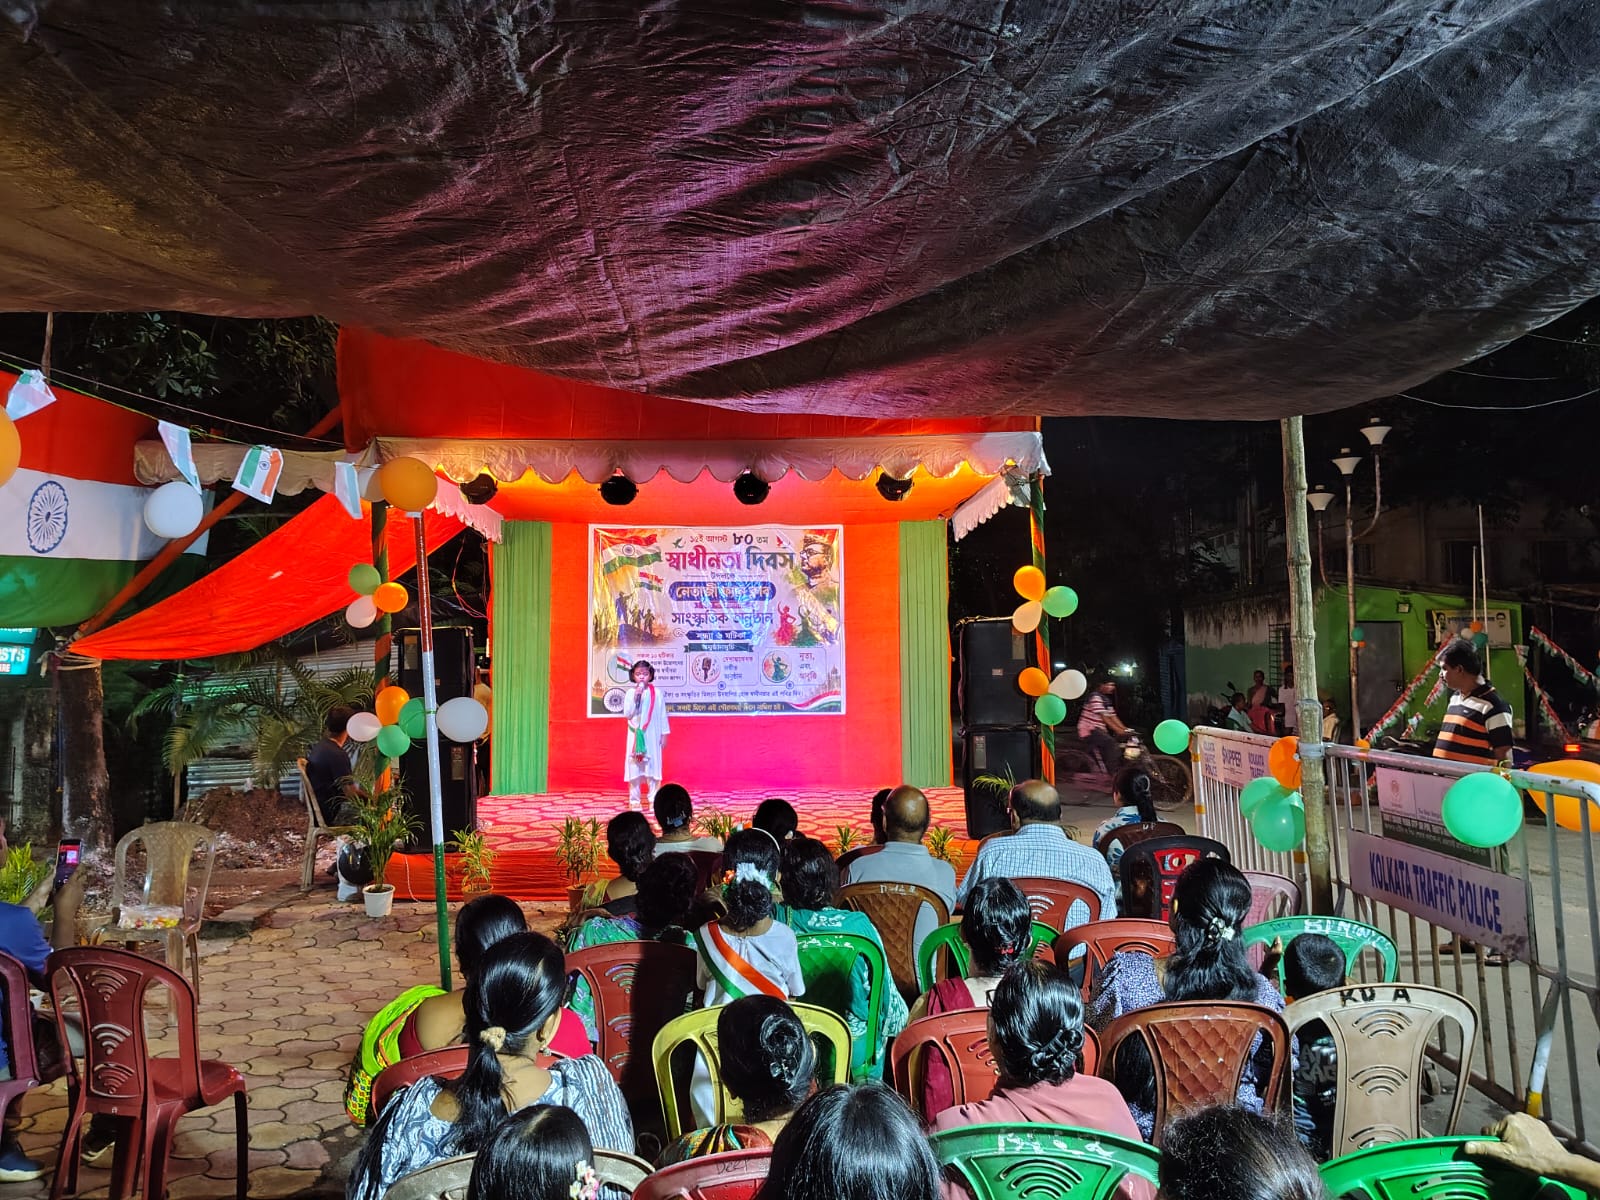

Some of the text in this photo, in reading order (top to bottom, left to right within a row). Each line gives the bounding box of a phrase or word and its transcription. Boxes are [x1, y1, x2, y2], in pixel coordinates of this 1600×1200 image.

[705, 534, 728, 543] আগস্ট
[732, 532, 753, 545] ৮০
[756, 536, 769, 544] তম
[664, 545, 796, 571] স্বাধীনতা দিবস
[671, 609, 774, 628] সাংস্কৃতিক অনুষ্ঠান
[1369, 851, 1503, 935] KOLKATA TRAFFIC POLICE
